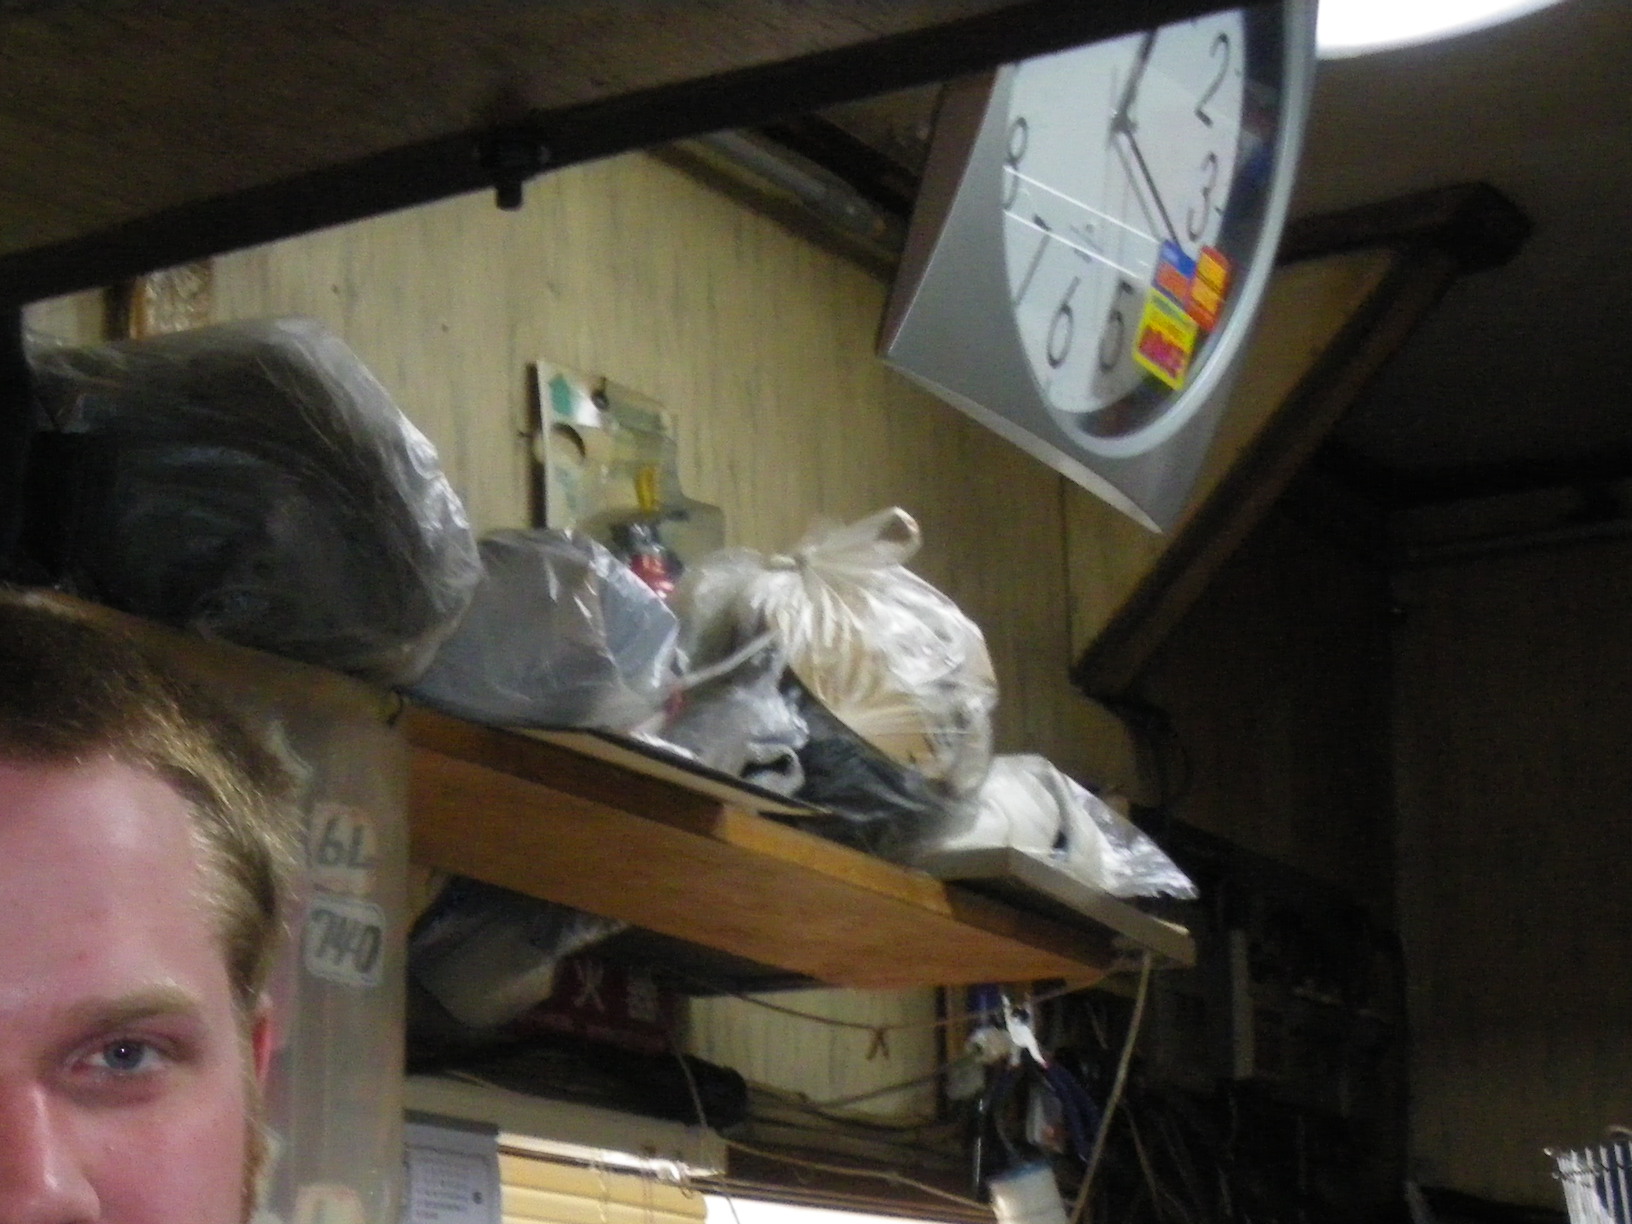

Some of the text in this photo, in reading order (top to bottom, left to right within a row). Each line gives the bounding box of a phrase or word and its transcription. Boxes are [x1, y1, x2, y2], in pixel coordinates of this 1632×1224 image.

[1194, 32, 1230, 127] 2
[1186, 153, 1218, 243] 3
[1017, 213, 1051, 307] 7
[1046, 276, 1081, 369] 6
